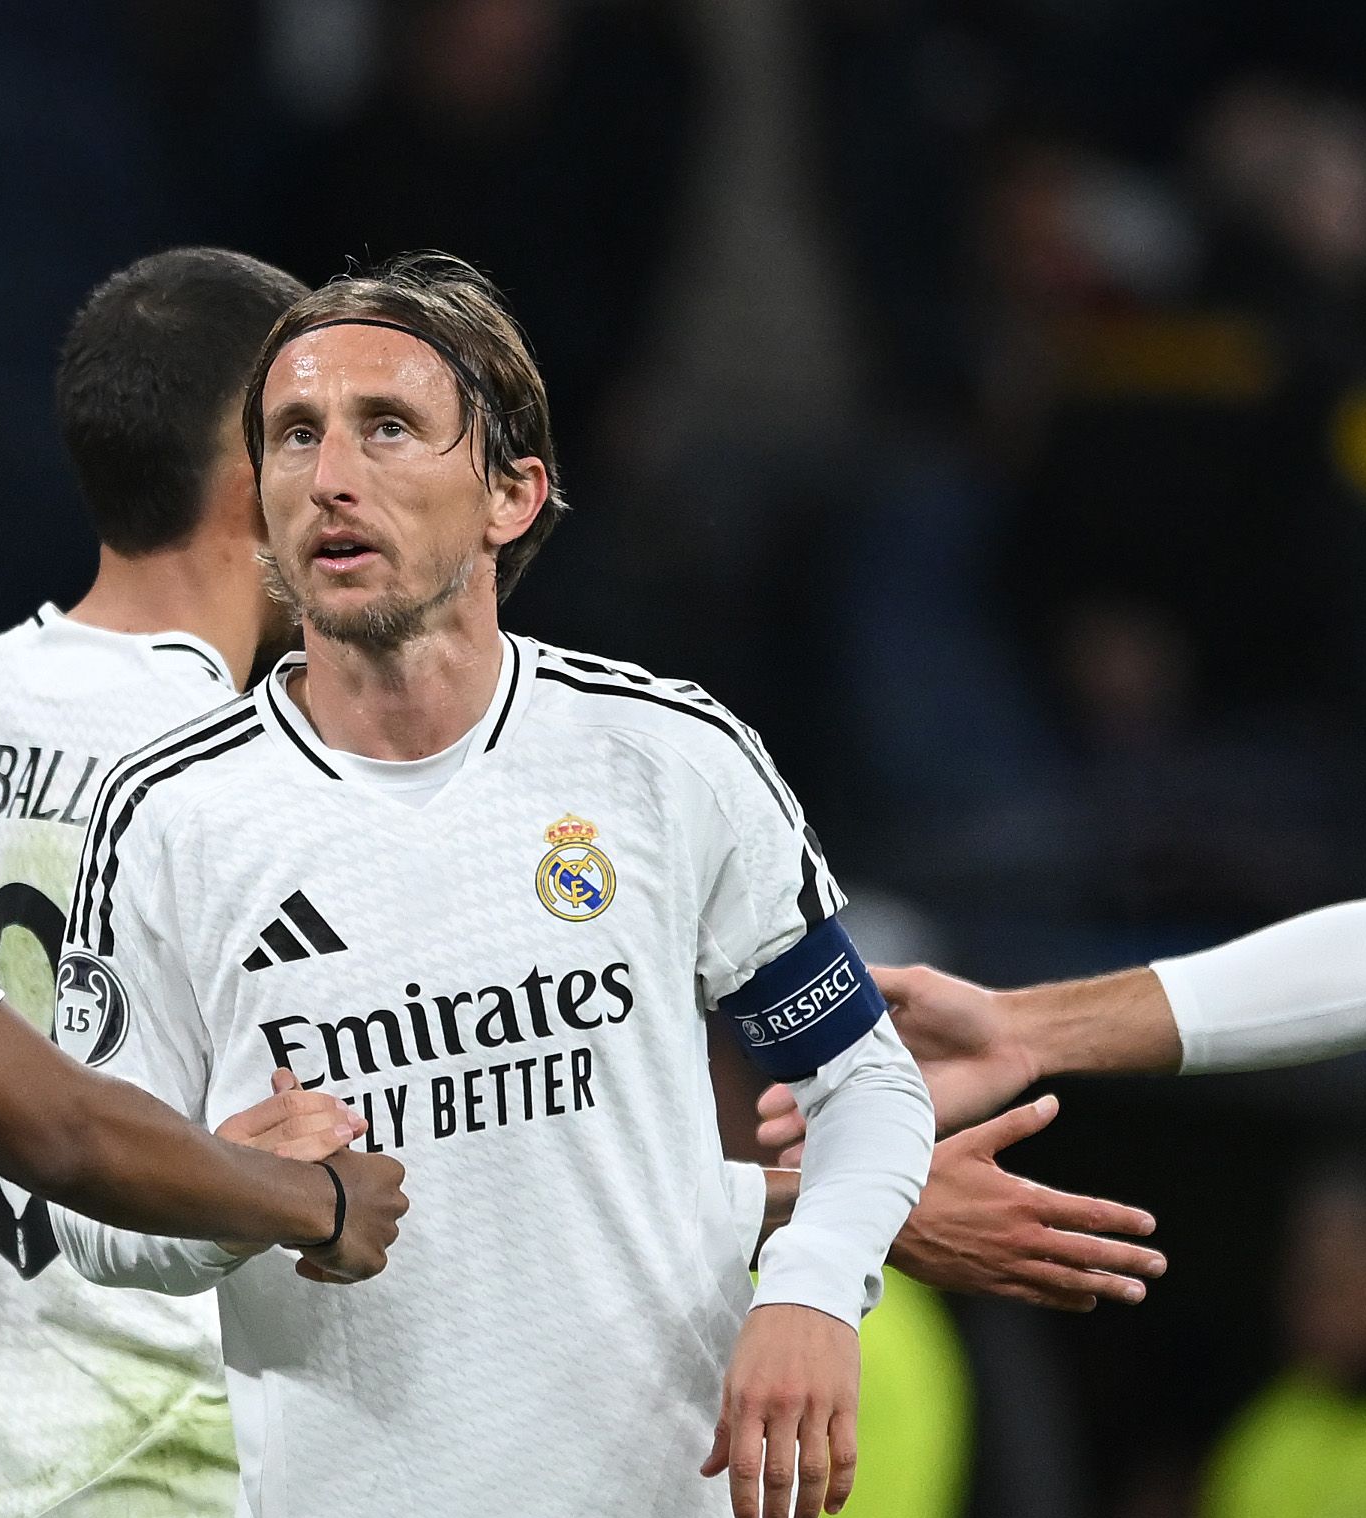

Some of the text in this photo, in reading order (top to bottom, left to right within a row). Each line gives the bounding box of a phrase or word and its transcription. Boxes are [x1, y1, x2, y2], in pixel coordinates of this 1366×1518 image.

[63, 1006, 91, 1033] 15
[258, 962, 635, 1091] Emirates
[767, 960, 856, 1034] RESPECT
[339, 1047, 596, 1154] LY BETTER
